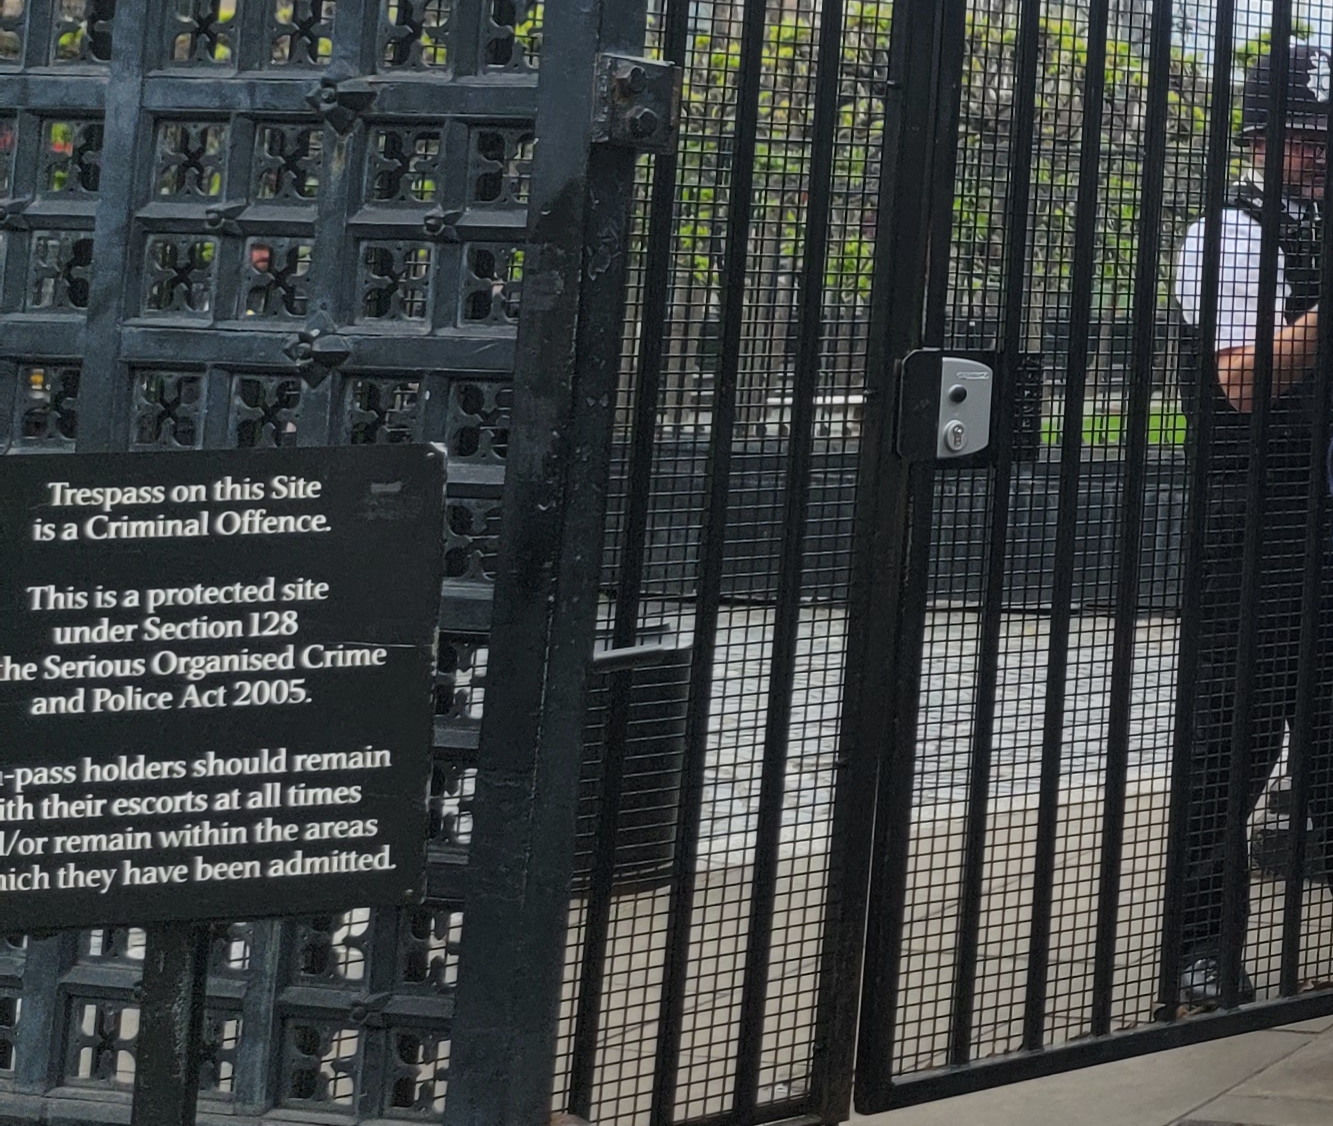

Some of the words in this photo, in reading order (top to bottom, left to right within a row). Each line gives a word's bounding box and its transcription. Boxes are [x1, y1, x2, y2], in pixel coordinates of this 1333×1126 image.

[47, 481, 166, 513] Trespass
[169, 484, 207, 503] on
[213, 475, 265, 502] this
[270, 475, 322, 500] Site
[33, 517, 56, 542] is
[60, 522, 79, 541] a
[84, 510, 209, 540] Criminal
[214, 508, 332, 536] Offence.
[25, 584, 89, 611] This
[94, 585, 118, 609] is
[121, 589, 140, 608] a
[146, 576, 276, 614] protected
[281, 577, 330, 602] site
[53, 617, 139, 645] under
[142, 615, 244, 642] Section
[248, 610, 299, 638] 128
[42, 654, 146, 680] Serious
[150, 643, 296, 681] Organised
[300, 642, 388, 669] Crime
[29, 687, 86, 716] and
[91, 685, 174, 713] Police
[177, 683, 228, 709] Act
[232, 678, 313, 707] 2005.
[0, 765, 77, 794] -pass
[82, 754, 187, 783] holders
[191, 747, 288, 778] should
[293, 745, 392, 773] remain
[40, 793, 108, 820] their
[110, 790, 209, 817] escorts
[212, 788, 242, 812] at
[245, 782, 282, 810] all
[286, 782, 362, 807] times
[53, 826, 153, 854] remain
[157, 820, 248, 849] within
[253, 817, 299, 844] the
[303, 818, 379, 841] areas
[56, 862, 118, 894] they
[122, 859, 189, 886] have
[194, 855, 262, 882] been
[266, 844, 397, 878] admitted.
